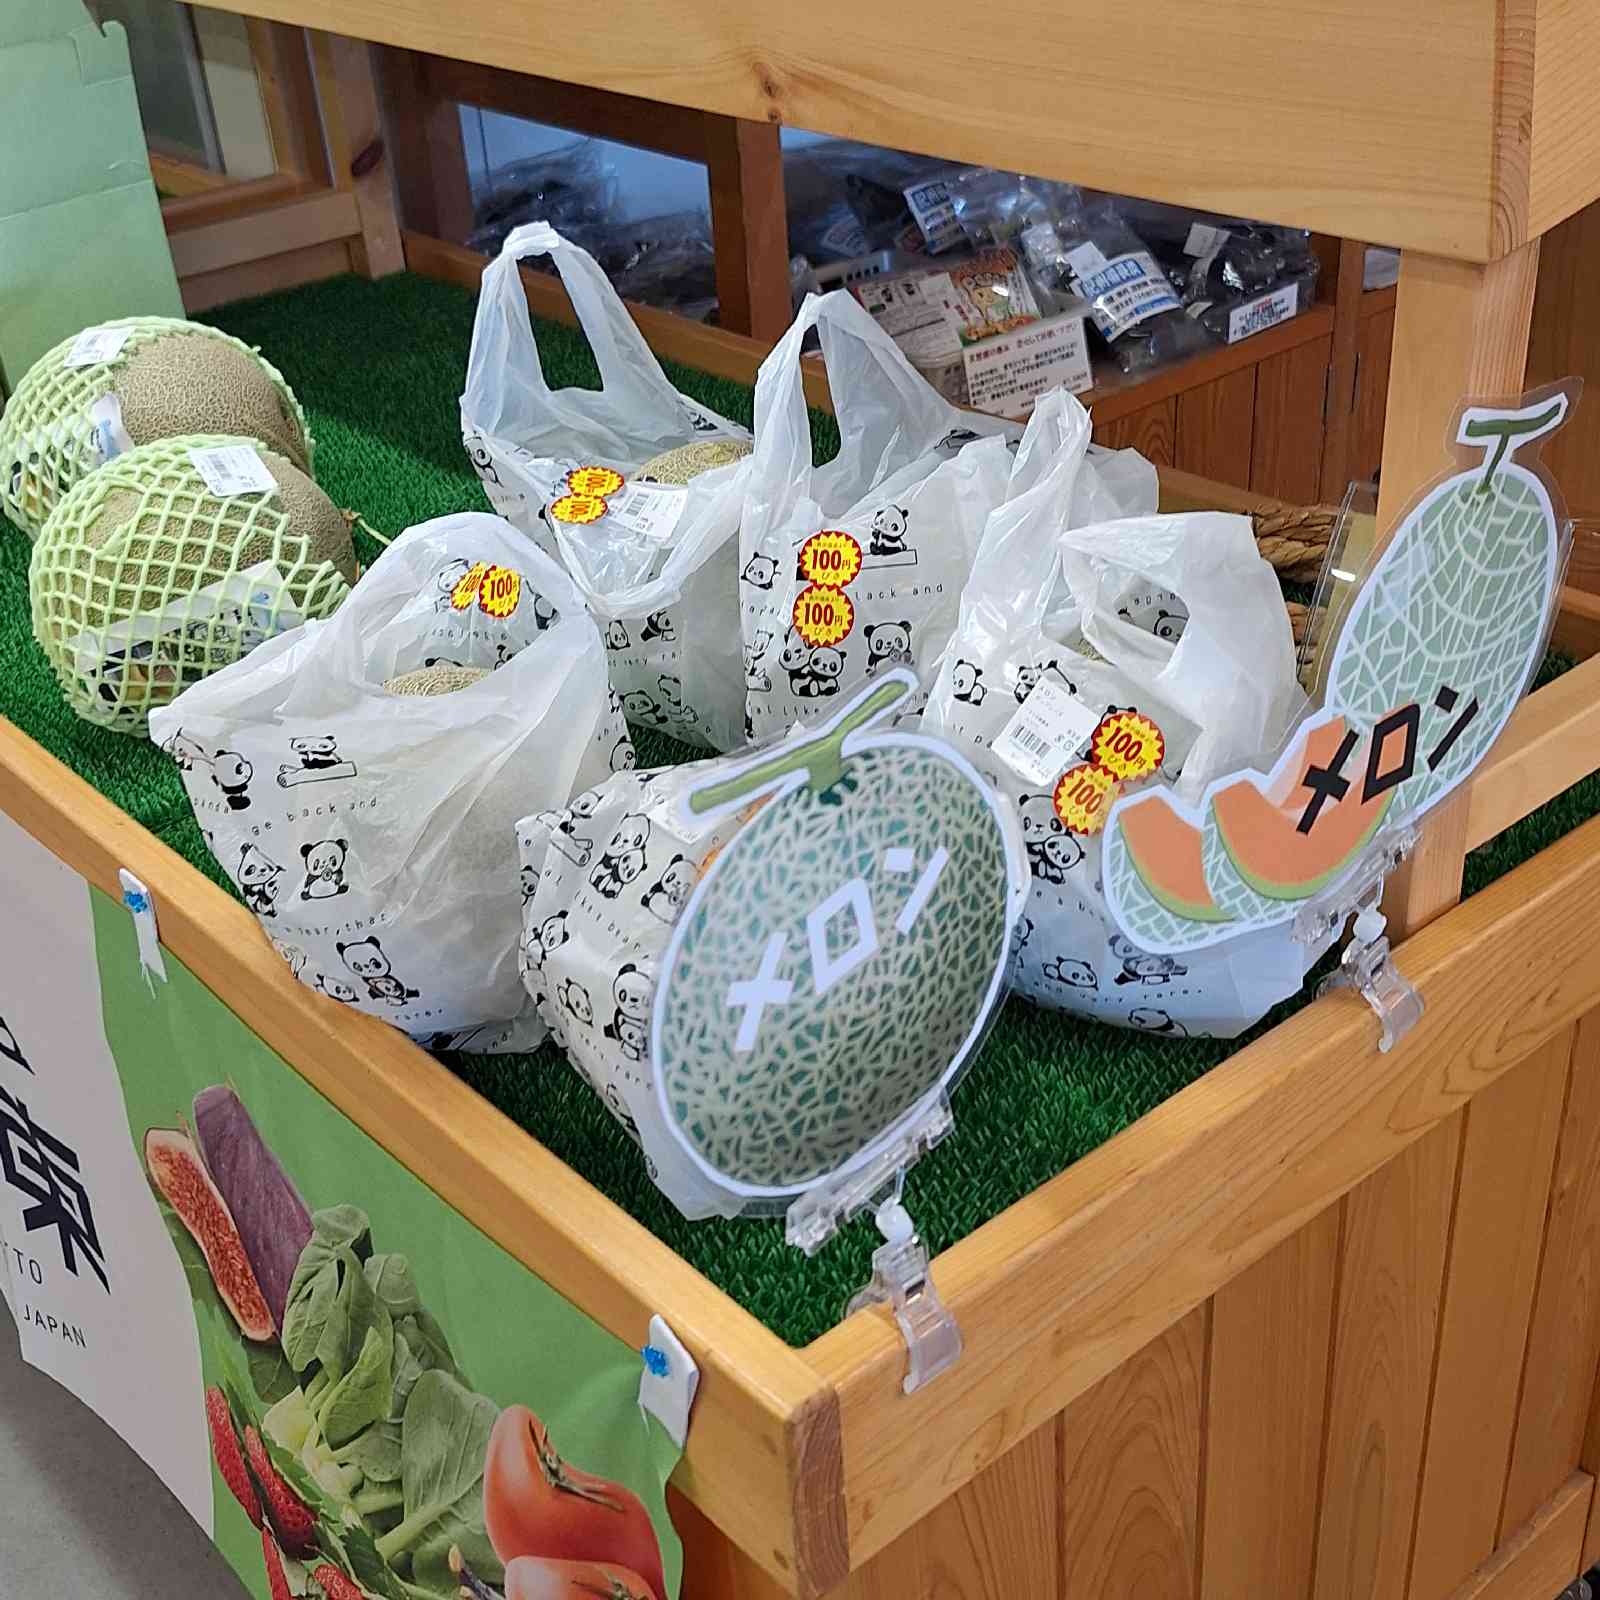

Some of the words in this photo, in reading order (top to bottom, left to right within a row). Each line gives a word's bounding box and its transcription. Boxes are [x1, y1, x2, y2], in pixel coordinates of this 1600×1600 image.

[812, 549, 851, 571] 100円
[805, 603, 843, 626] 100円
[1104, 726, 1146, 769] 100円
[1296, 685, 1479, 835] メロン
[287, 802, 337, 822] back
[726, 846, 950, 1052] メロン
[23, 1304, 86, 1349] JAPAN
